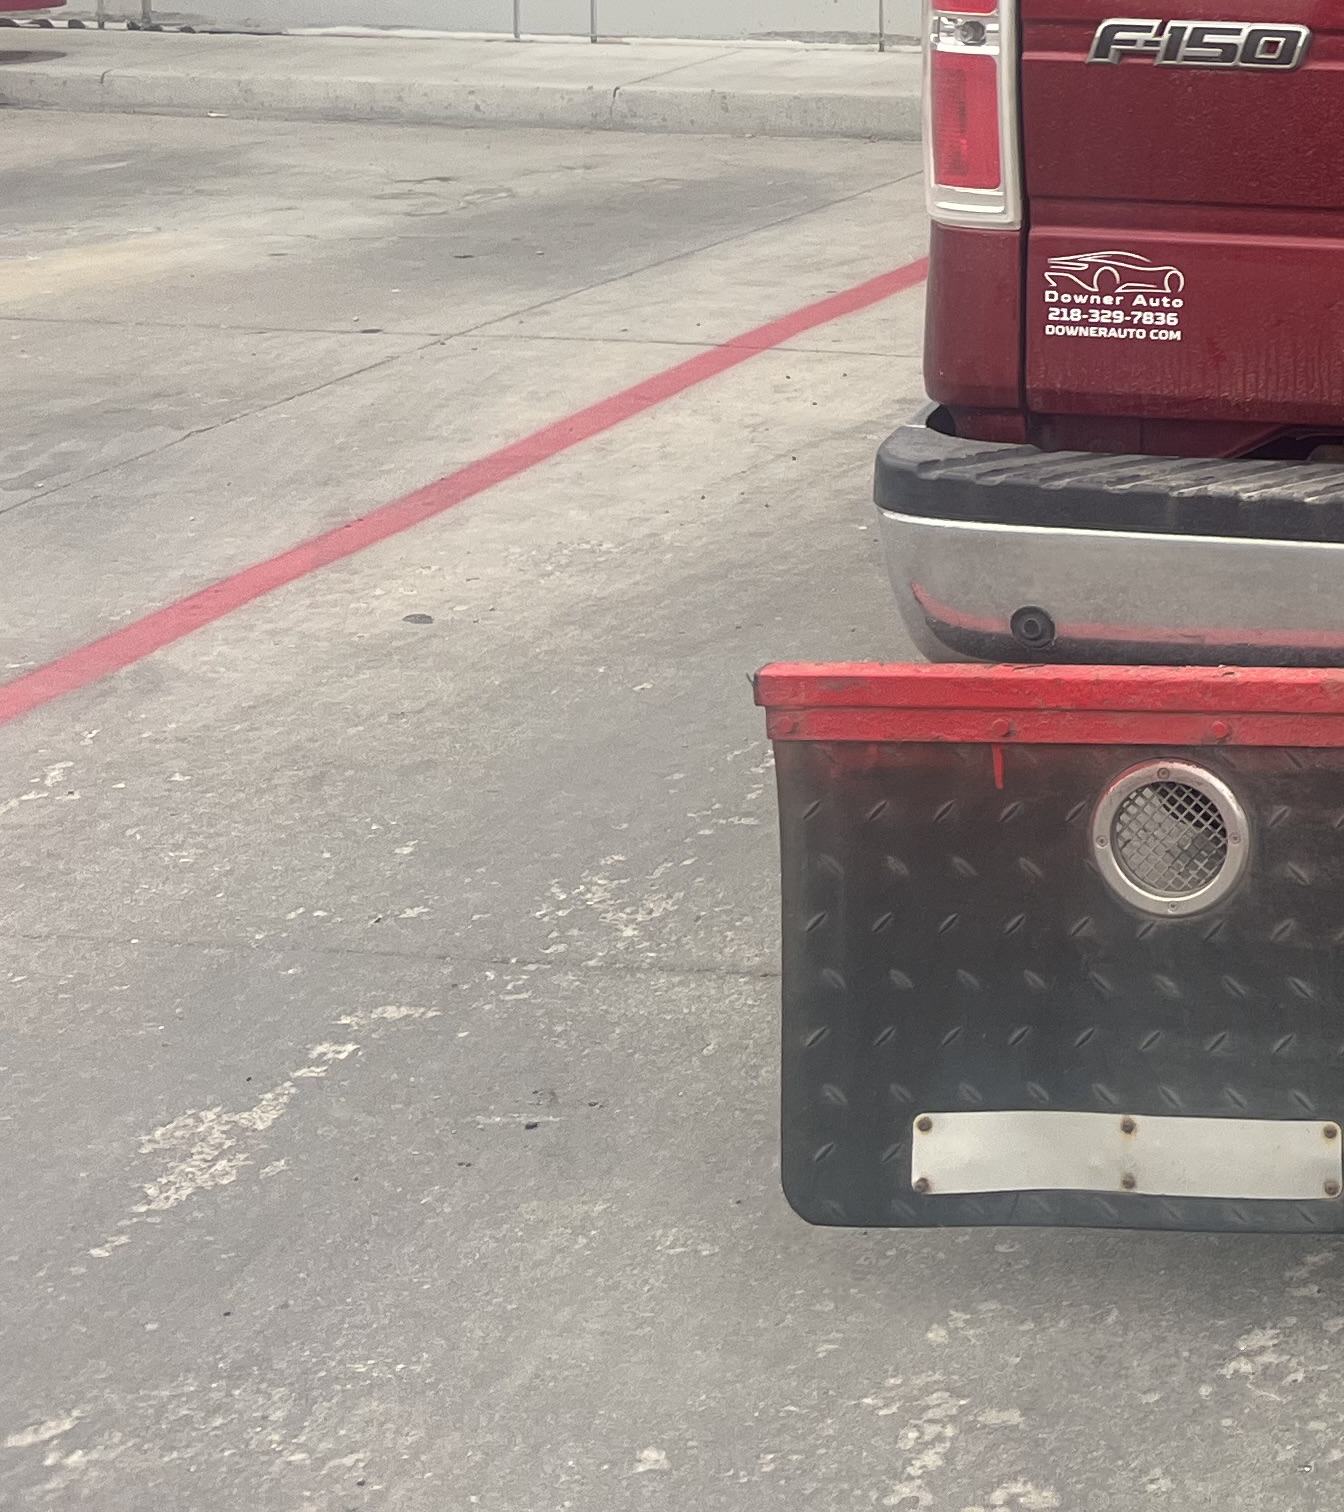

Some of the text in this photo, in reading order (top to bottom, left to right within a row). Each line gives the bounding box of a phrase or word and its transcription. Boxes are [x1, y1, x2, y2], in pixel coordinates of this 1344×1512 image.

[1085, 17, 1311, 69] F-150
[1044, 290, 1184, 308] Downer Auto
[1048, 307, 1179, 326] 218-329-7836
